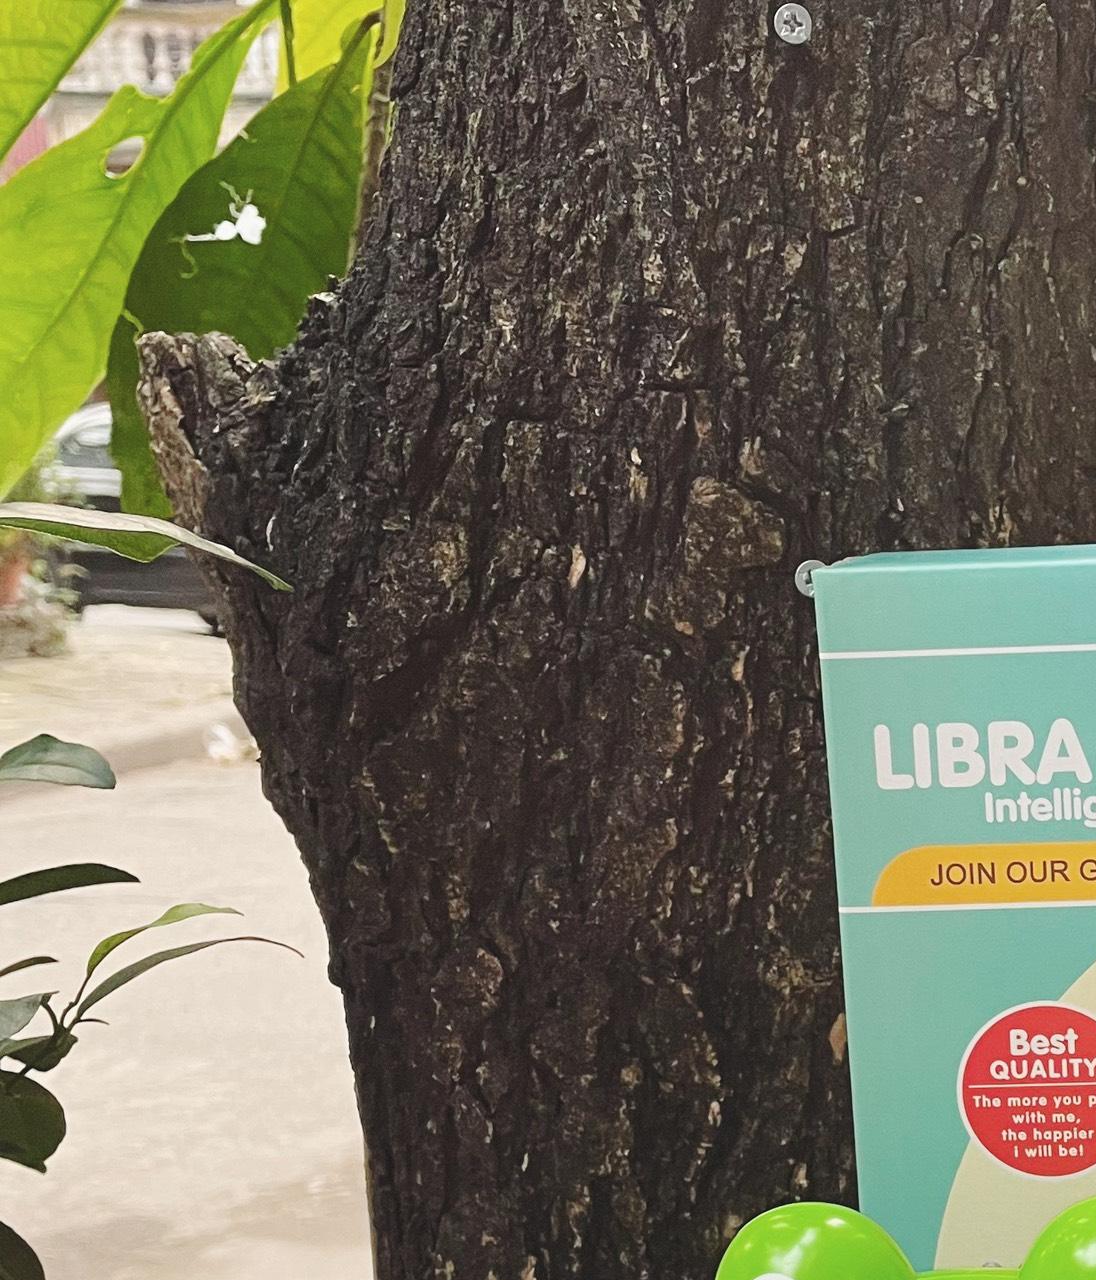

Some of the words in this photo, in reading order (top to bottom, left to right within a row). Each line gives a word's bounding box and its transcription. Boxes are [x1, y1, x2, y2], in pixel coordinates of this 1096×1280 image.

[874, 718, 1093, 790] LIBRA
[930, 862, 996, 886] JOIN
[1006, 860, 1068, 883] OUR
[1009, 1028, 1078, 1056] Best
[973, 1095, 1001, 1108] The
[1007, 1095, 1047, 1107] more
[1053, 1094, 1082, 1108] you
[1012, 1111, 1045, 1124] with
[1052, 1112, 1081, 1124] me,
[1002, 1129, 1027, 1141] the
[1033, 1127, 1094, 1143] happier
[1025, 1144, 1052, 1157] will
[1058, 1144, 1084, 1157] be!
